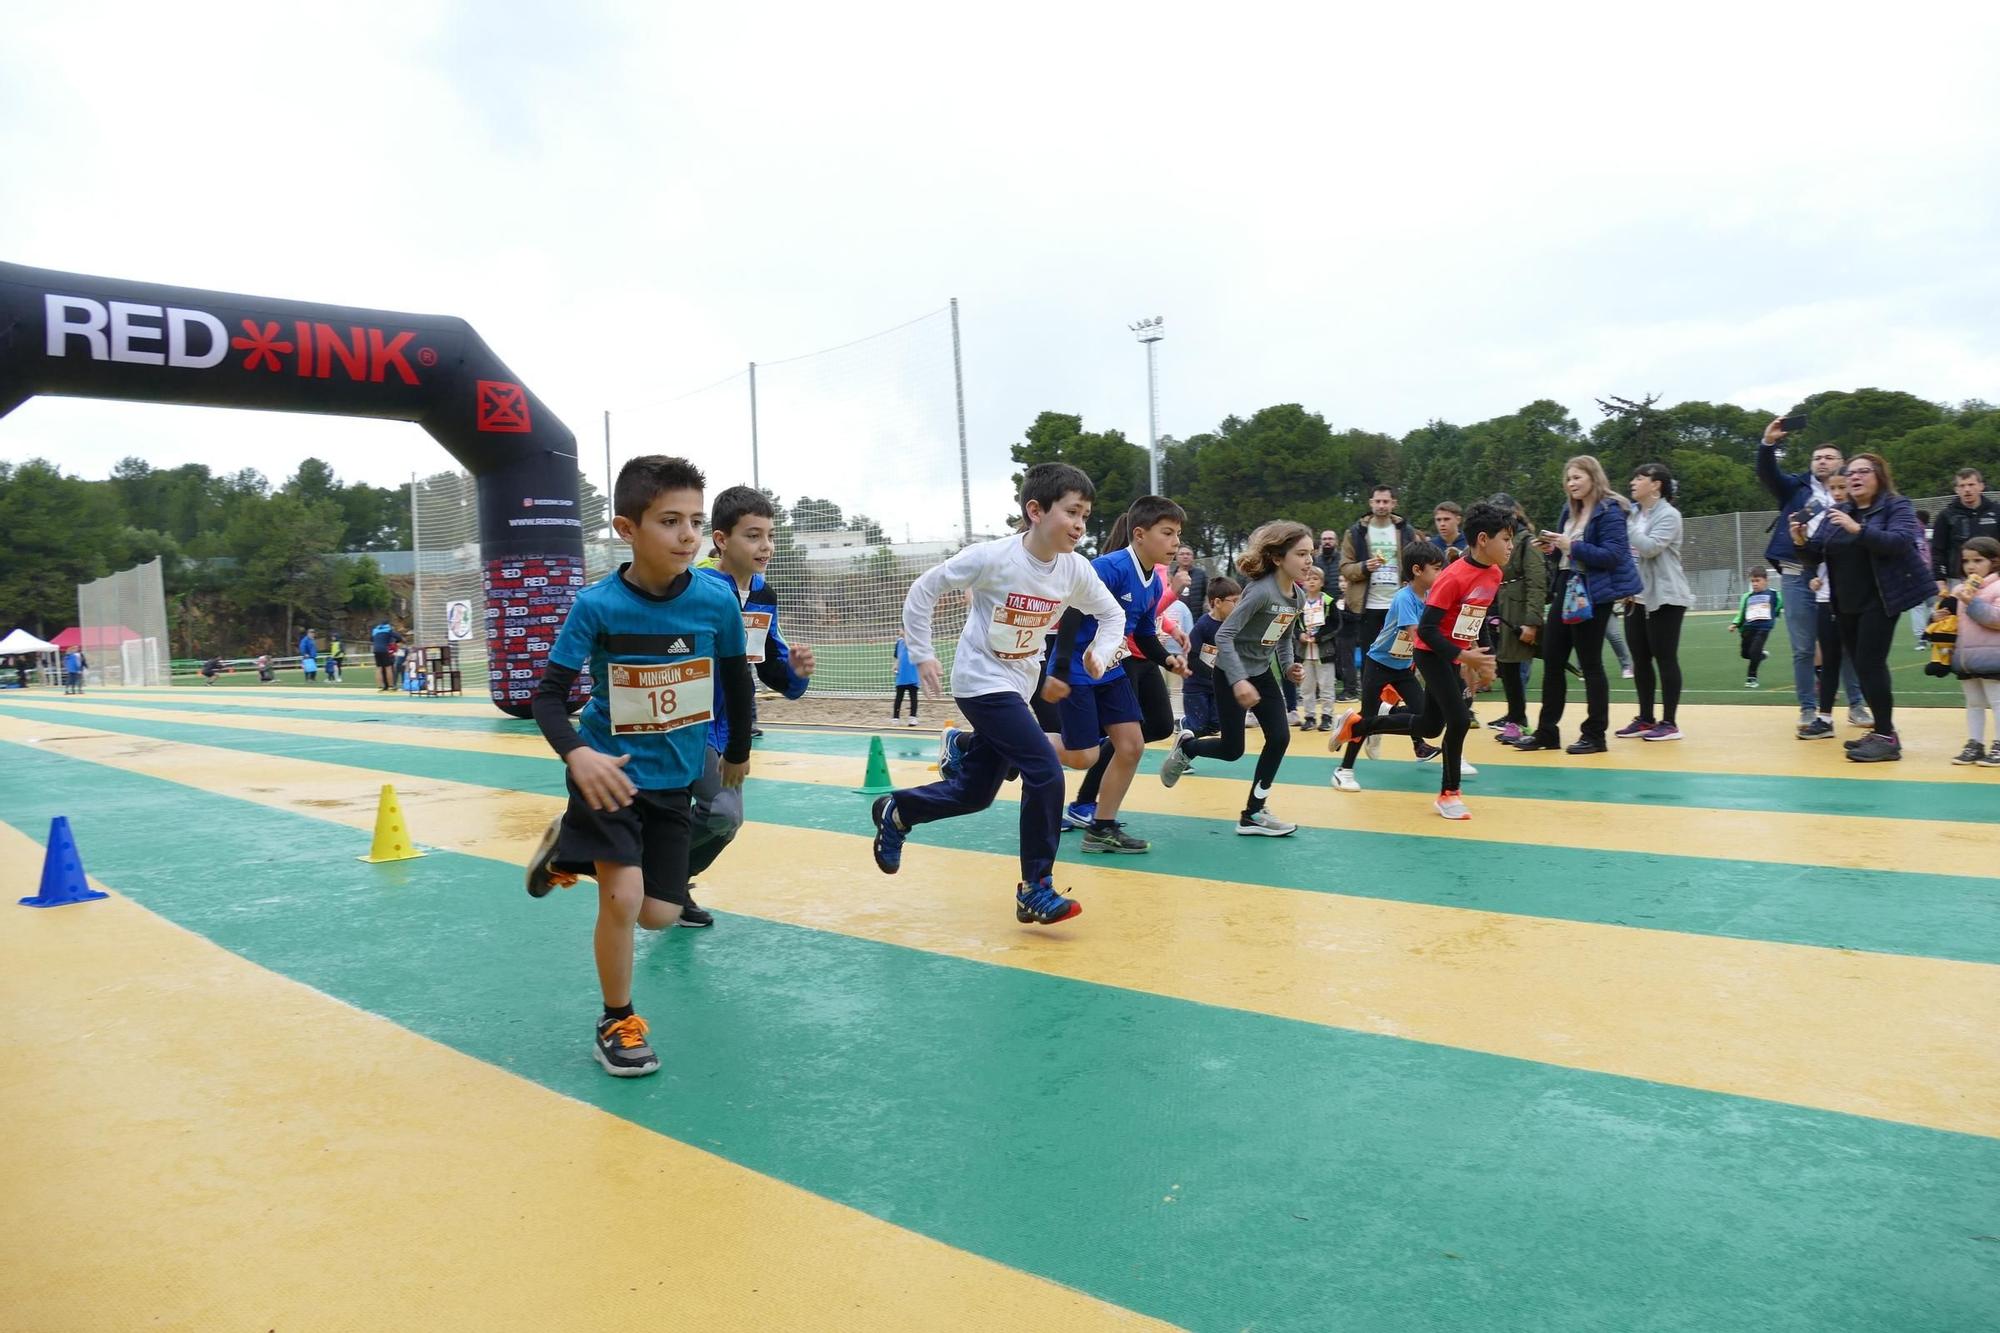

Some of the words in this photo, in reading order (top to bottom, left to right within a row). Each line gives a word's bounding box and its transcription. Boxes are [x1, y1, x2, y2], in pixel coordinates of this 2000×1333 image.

[523, 577, 548, 587] RED
[1008, 595, 1025, 609] TAE
[1026, 598, 1052, 612] KWON
[505, 607, 528, 616] RED
[504, 628, 526, 637] RED
[1015, 629, 1033, 648] 12
[527, 642, 550, 651] RED
[510, 669, 533, 678] RED
[509, 690, 531, 699] RED
[647, 689, 677, 717] 18
